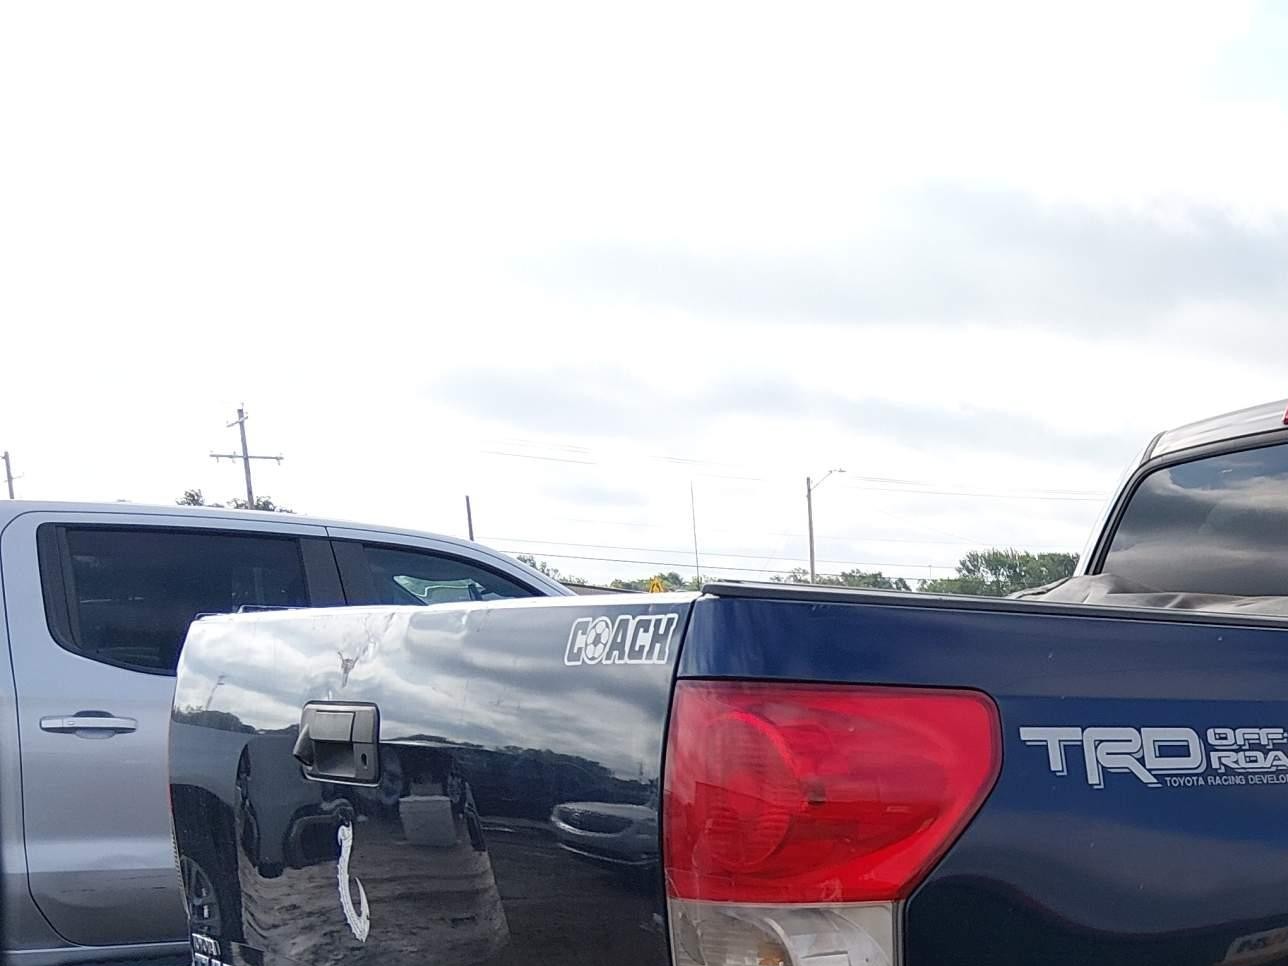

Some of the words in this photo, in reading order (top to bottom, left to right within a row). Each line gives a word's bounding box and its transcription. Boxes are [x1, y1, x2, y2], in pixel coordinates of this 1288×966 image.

[564, 613, 678, 666] COACH
[1206, 728, 1288, 749] OFF
[1019, 727, 1207, 789] TRD
[1165, 776, 1205, 788] TOYOTA
[1207, 775, 1246, 786] RACING
